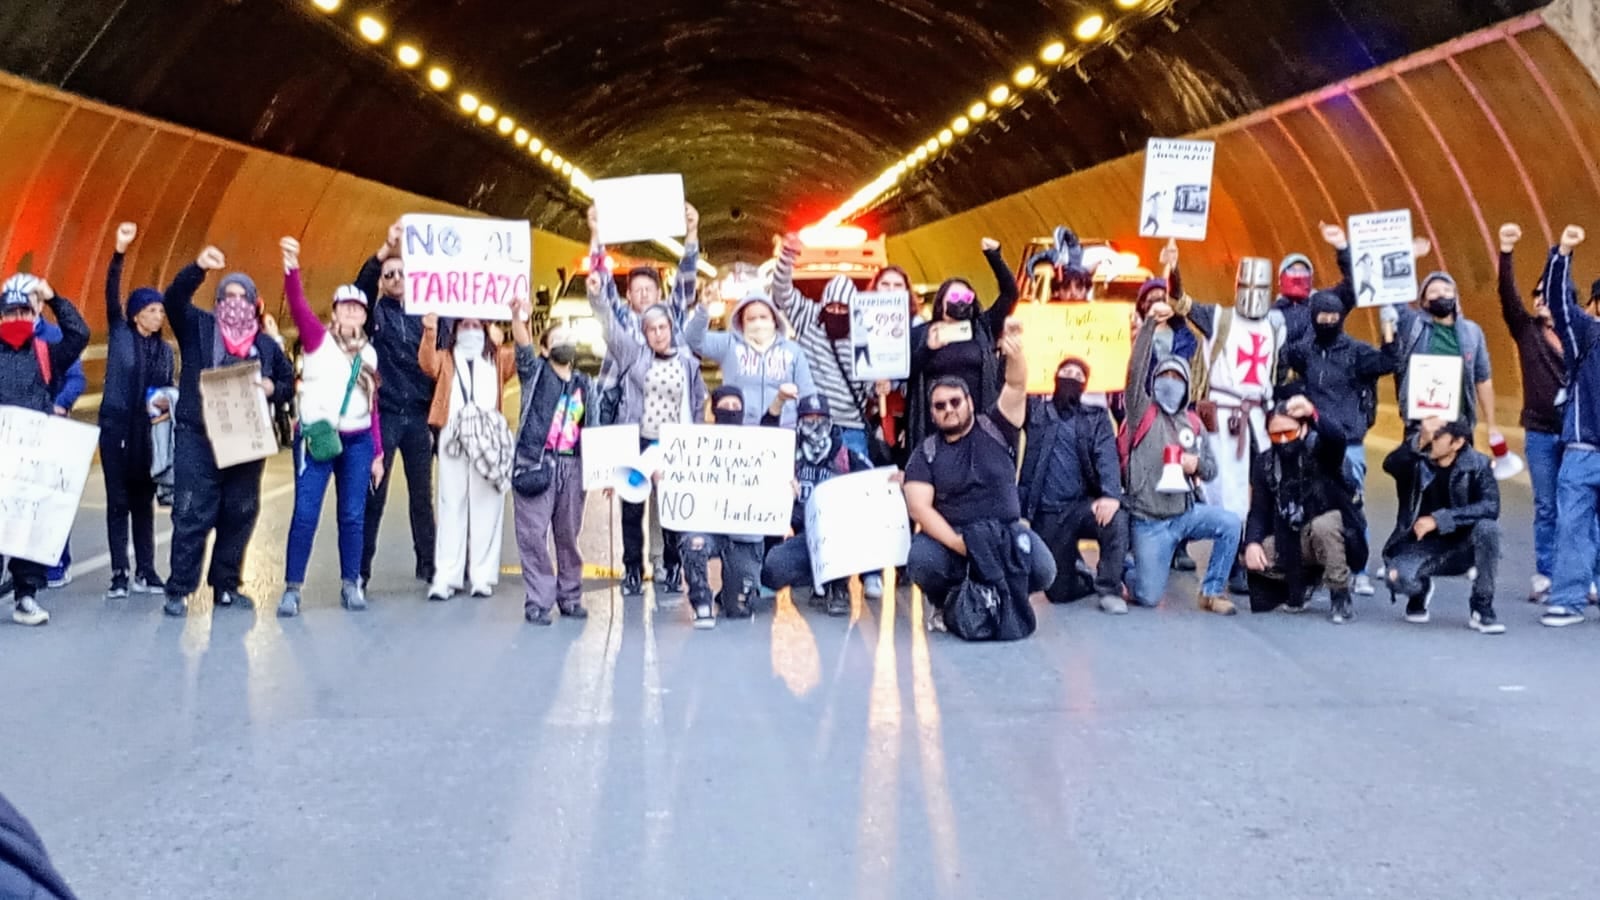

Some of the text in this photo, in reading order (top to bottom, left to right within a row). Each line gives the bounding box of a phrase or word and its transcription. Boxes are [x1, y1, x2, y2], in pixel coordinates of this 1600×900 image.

[406, 223, 524, 263] NO AL
[408, 271, 529, 304] TARIFAZO
[661, 490, 696, 521] NO
